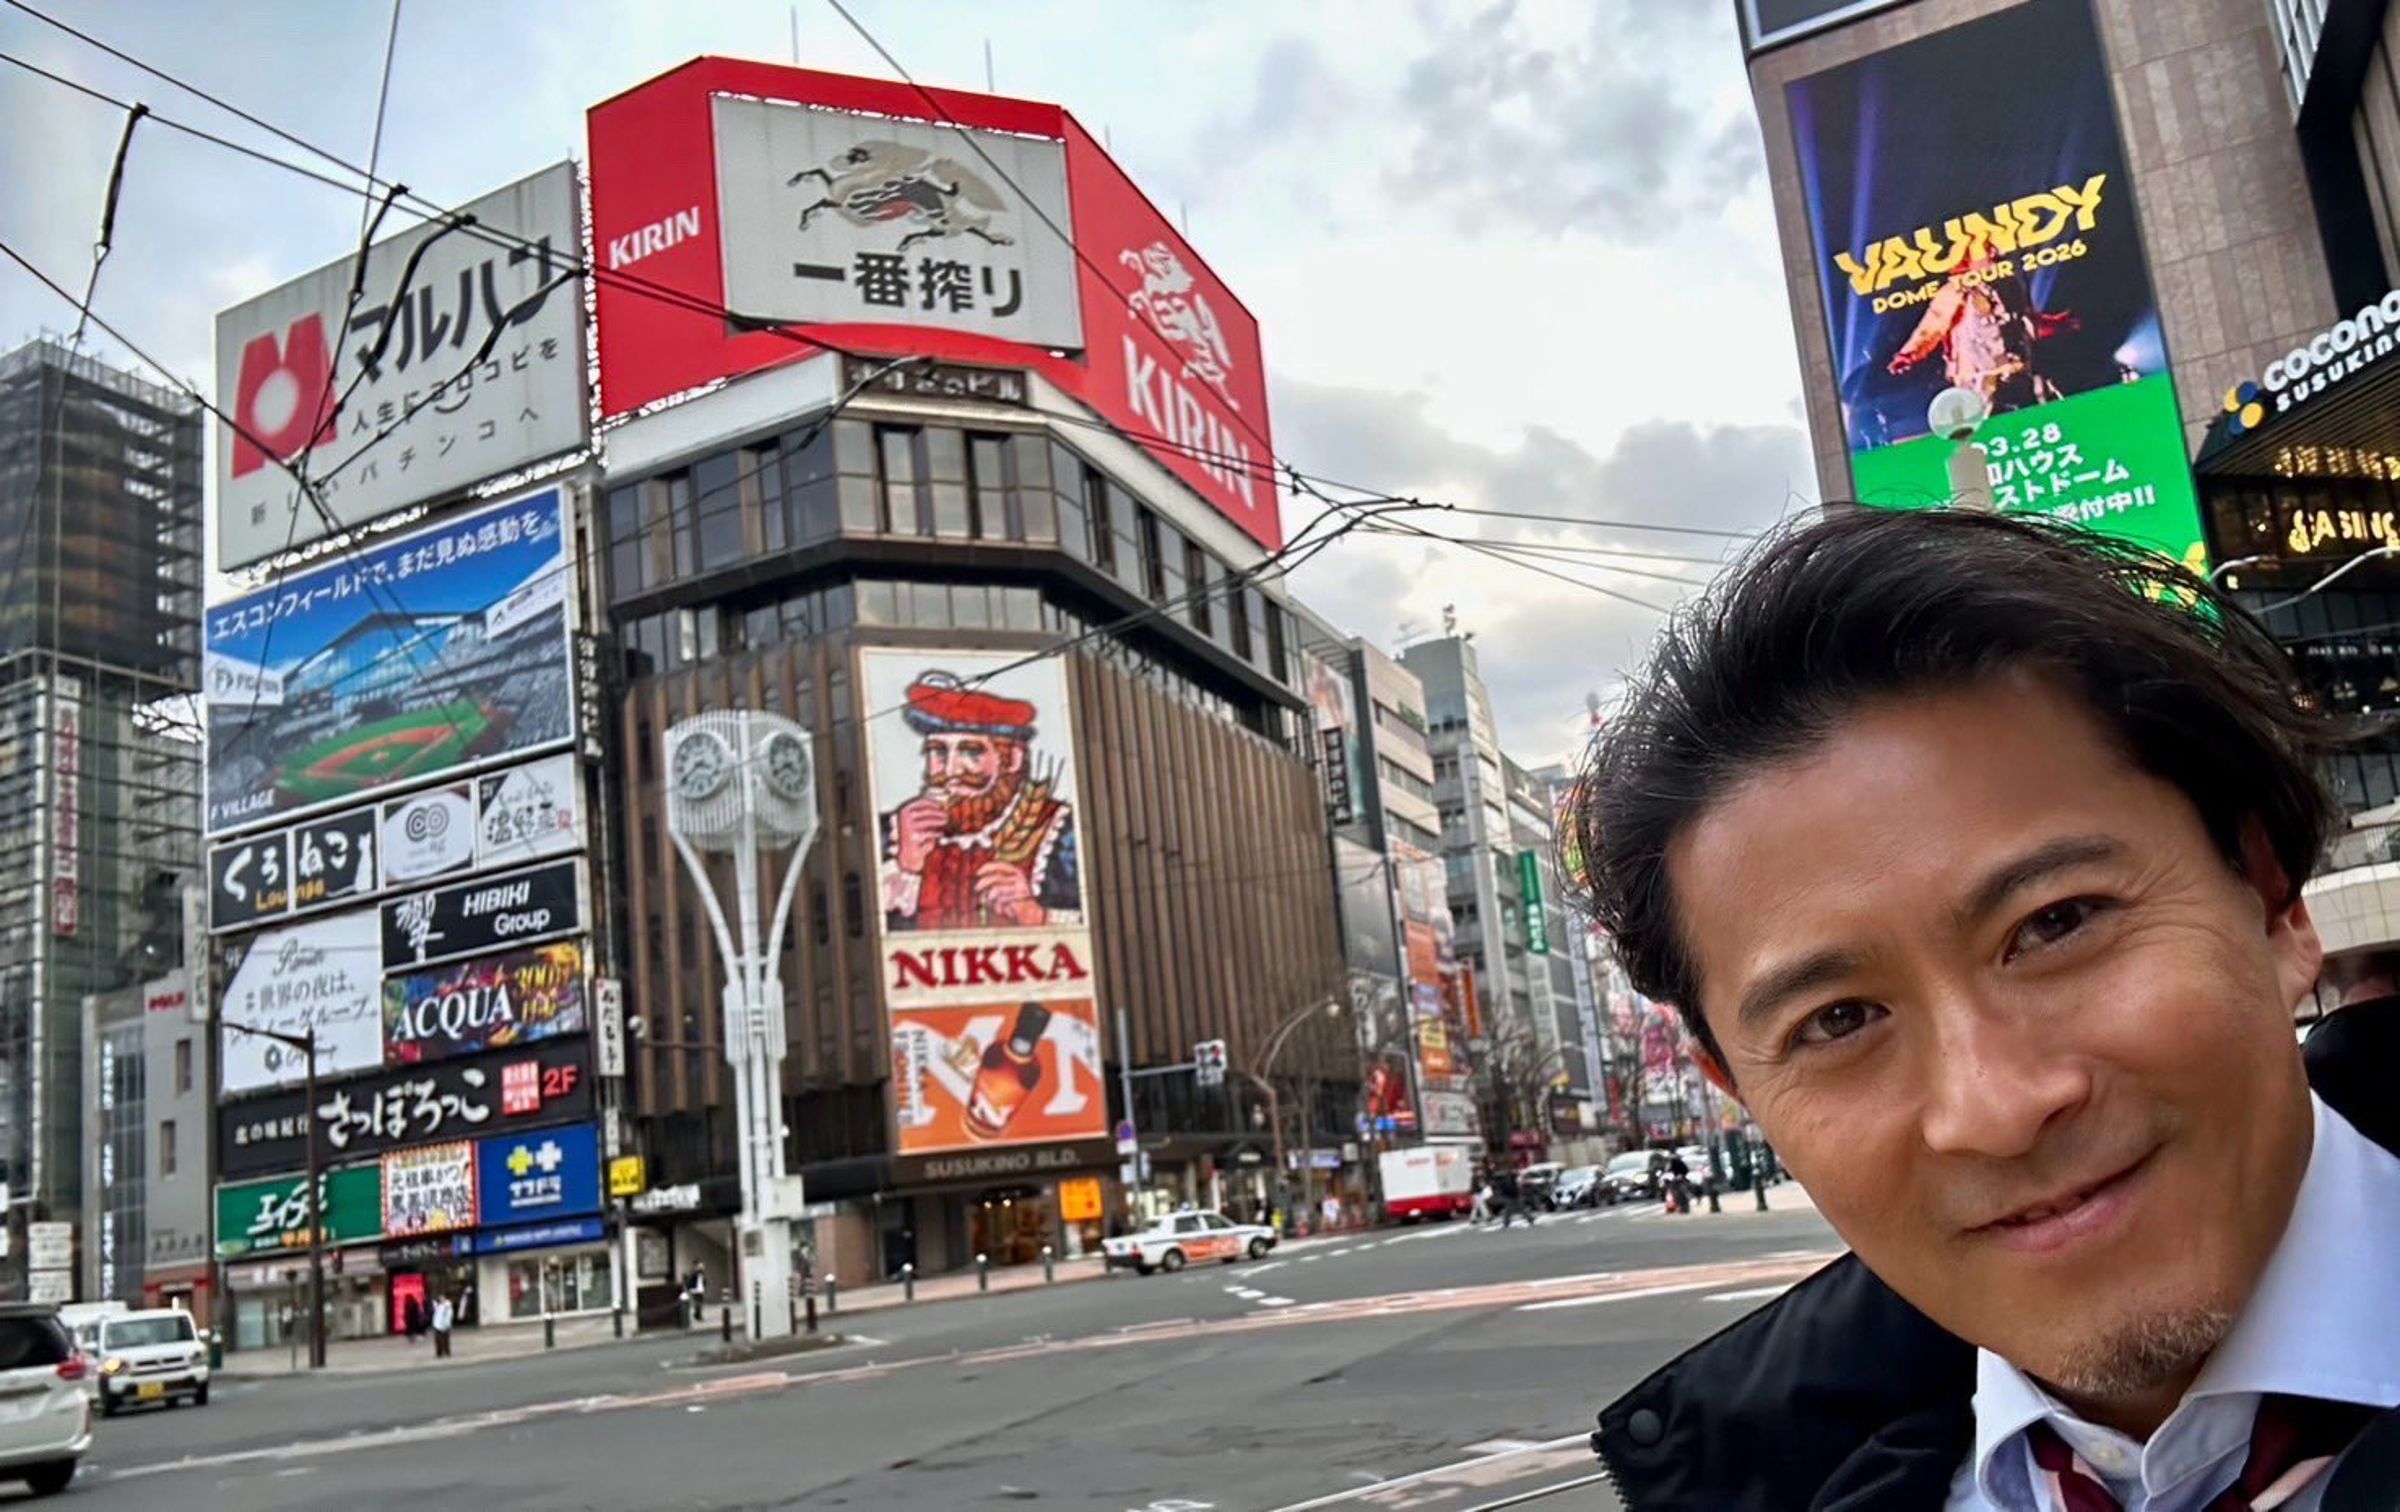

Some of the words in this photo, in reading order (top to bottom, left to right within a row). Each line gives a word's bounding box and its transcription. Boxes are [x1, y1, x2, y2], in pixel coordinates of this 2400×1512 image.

[607, 206, 700, 270] KIRIN
[1834, 174, 2106, 296] VAUNDY
[349, 234, 551, 383] マルハン
[794, 251, 1022, 317] 一番搾り
[1872, 280, 1939, 314] DOME
[1952, 261, 2014, 293] TOUR
[2022, 239, 2088, 273] 2026
[2276, 324, 2400, 412] SUSUKIN
[1123, 336, 1255, 510] KIRIN
[224, 831, 349, 902] くろねこ
[463, 882, 531, 917] HIBIKI
[495, 907, 551, 936] Group
[889, 942, 1088, 990] NIKKA
[392, 984, 514, 1042] ACQUA
[317, 1067, 490, 1148] さっぽろっこ
[543, 1064, 578, 1097] 2F
[923, 1154, 1030, 1180] SUSUKINO
[1035, 1147, 1082, 1169] BLD.
